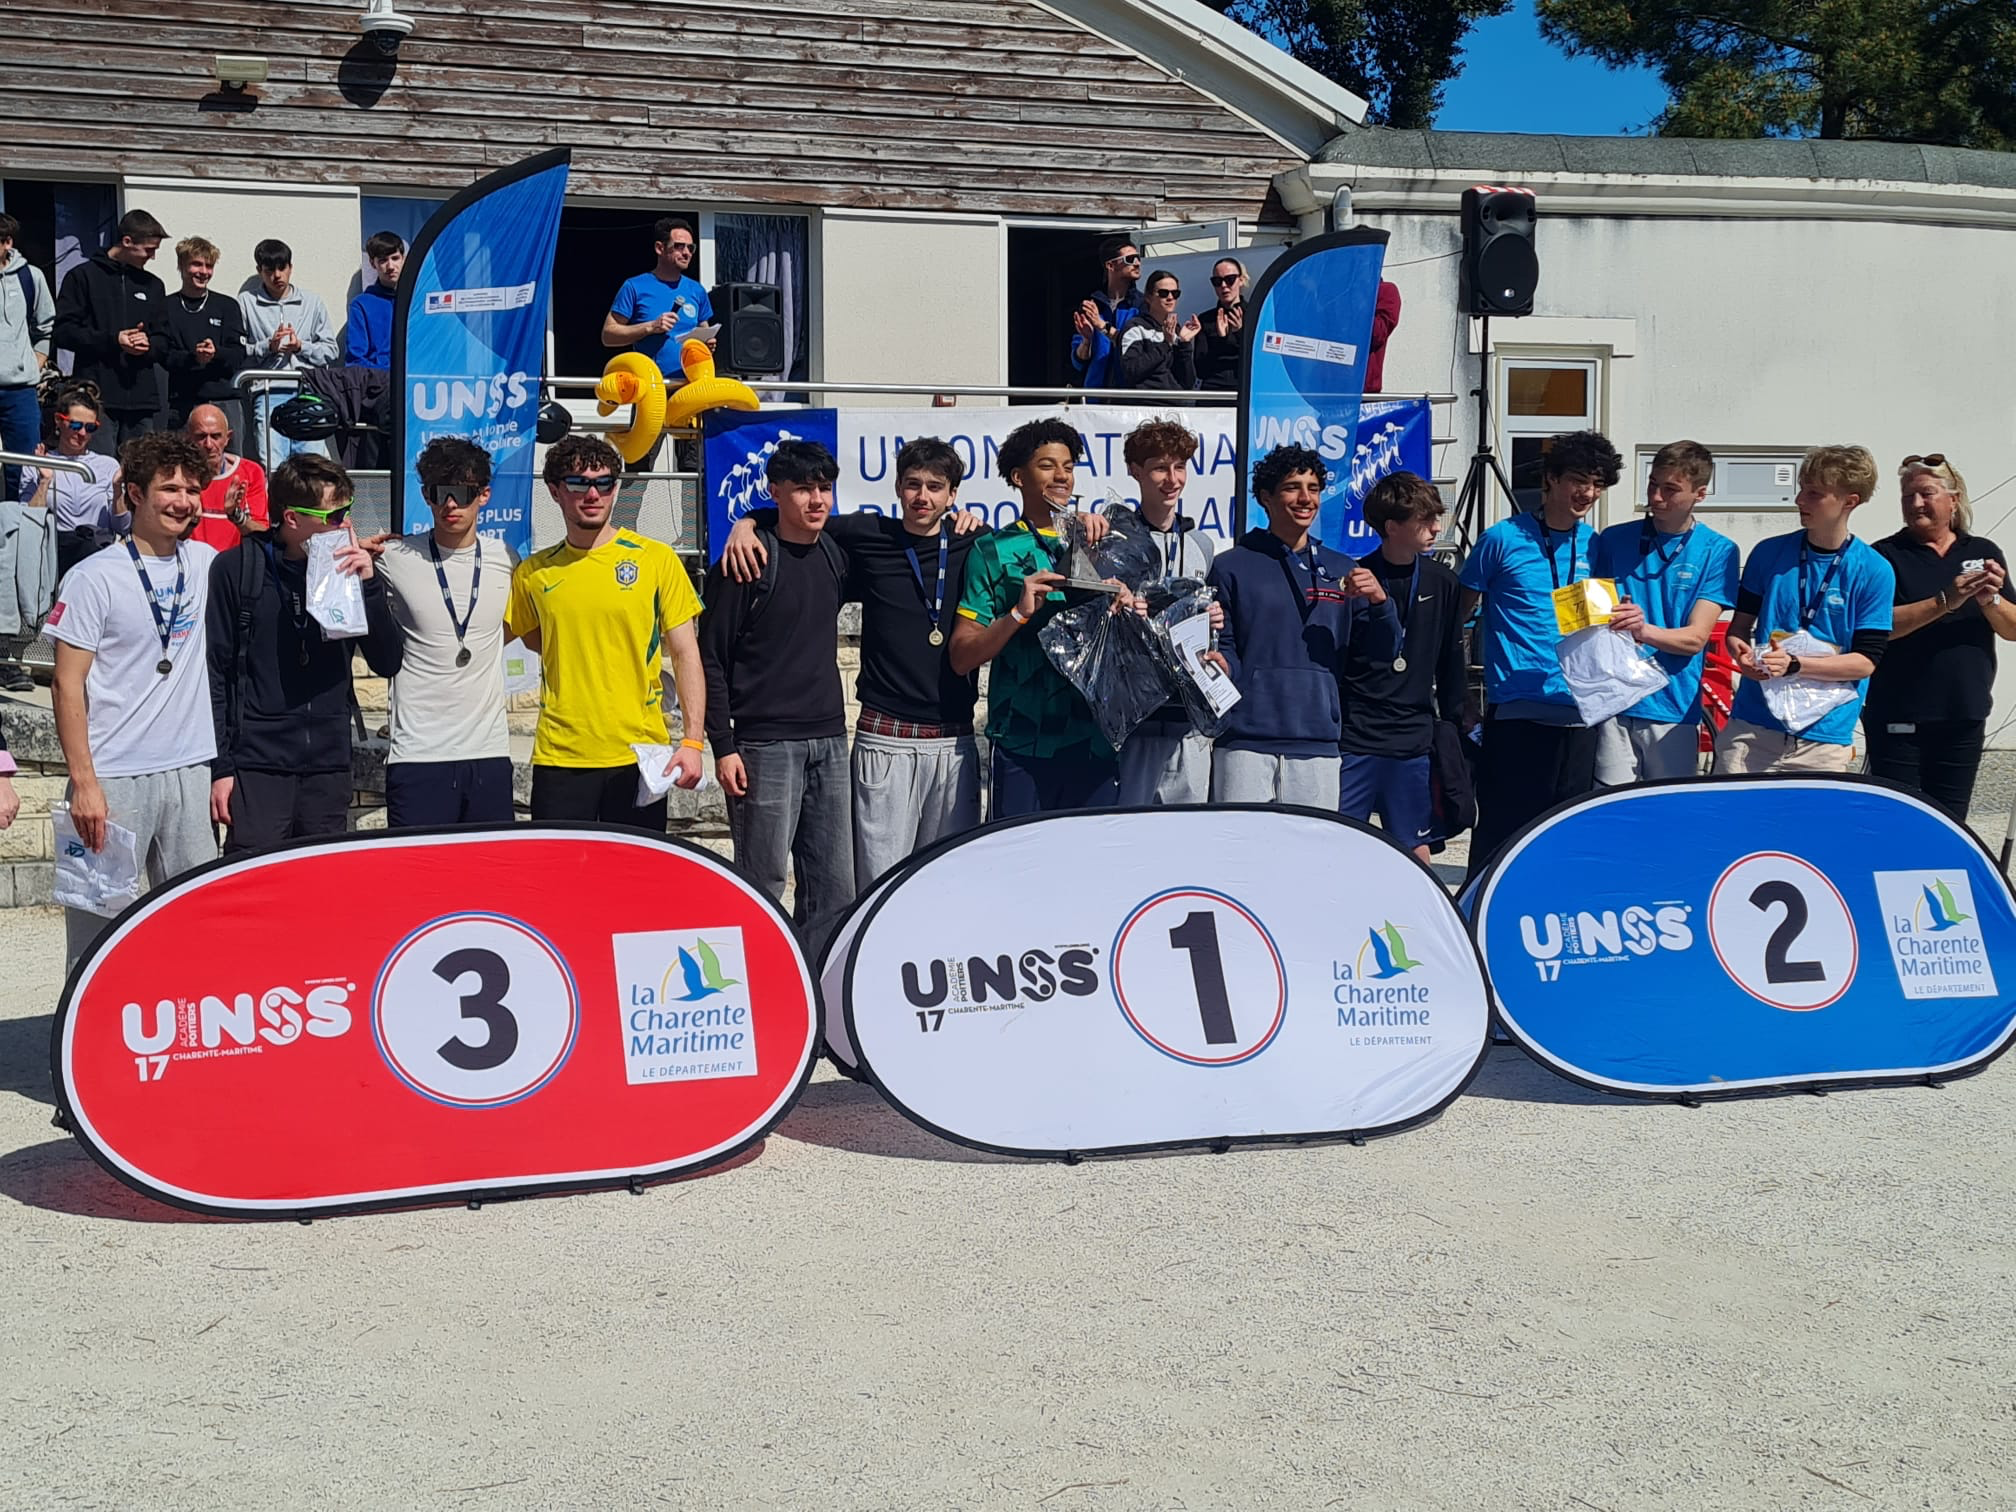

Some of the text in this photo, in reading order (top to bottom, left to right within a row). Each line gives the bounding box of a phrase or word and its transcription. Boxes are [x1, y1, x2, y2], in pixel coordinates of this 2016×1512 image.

[413, 371, 528, 421] UNSS
[1255, 416, 1348, 461] UNSS
[486, 508, 522, 522] PLUS
[1519, 906, 1693, 959] UNSS
[1568, 917, 1580, 955] POITIERS
[1748, 880, 1826, 984] 2
[1893, 915, 1911, 934] la
[1897, 936, 1980, 955] Charente
[1169, 911, 1237, 1044] 1
[1333, 960, 1353, 980] la
[1534, 959, 1561, 982] 17
[1901, 956, 1982, 976] Maritime
[901, 949, 1098, 1008] UNSS
[956, 962, 968, 1002] POITIERS
[1914, 983, 1985, 994] LE DÉPARTEMENT
[631, 984, 655, 1006] la
[1334, 984, 1429, 1004] Charente
[432, 948, 518, 1071] 3
[630, 1005, 746, 1032] Charente
[948, 1002, 1025, 1014] CHARENTE-MARITIME
[1337, 1006, 1430, 1026] Maritime
[122, 986, 352, 1055] UNSS
[187, 1002, 198, 1048] POITIERS
[916, 1009, 945, 1032] 17
[630, 1031, 744, 1056] Maritime
[1350, 1036, 1432, 1046] LE DÉPARTEMENT
[172, 1045, 263, 1061] CHARENTE-MARITIME
[135, 1055, 170, 1082] 17
[642, 1061, 743, 1078] LE DÉPARTEMENT
